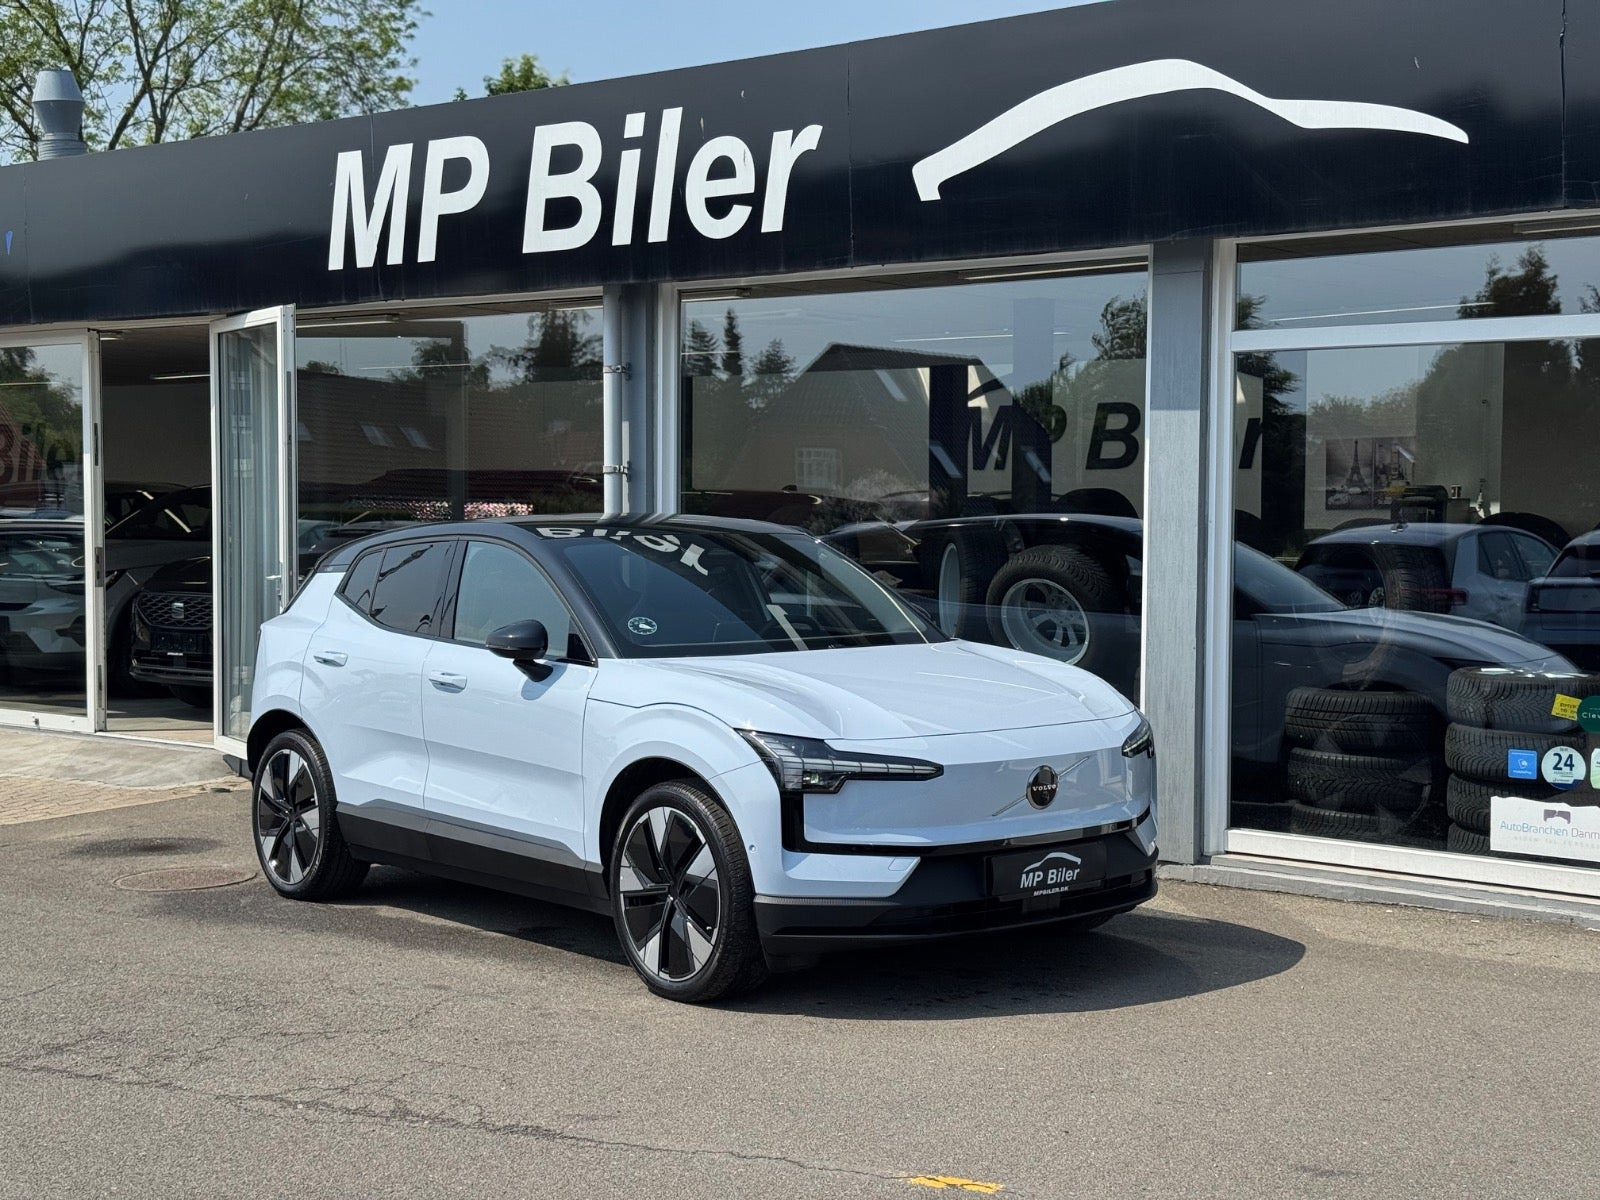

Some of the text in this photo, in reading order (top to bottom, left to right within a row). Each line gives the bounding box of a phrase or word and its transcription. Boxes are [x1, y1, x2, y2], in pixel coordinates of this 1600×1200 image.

[328, 107, 823, 271] MP Biler
[1552, 752, 1575, 771] 24
[1032, 784, 1057, 792] VOLVO
[1500, 820, 1568, 837] AutoBranchen
[1020, 867, 1080, 889] MP Biler
